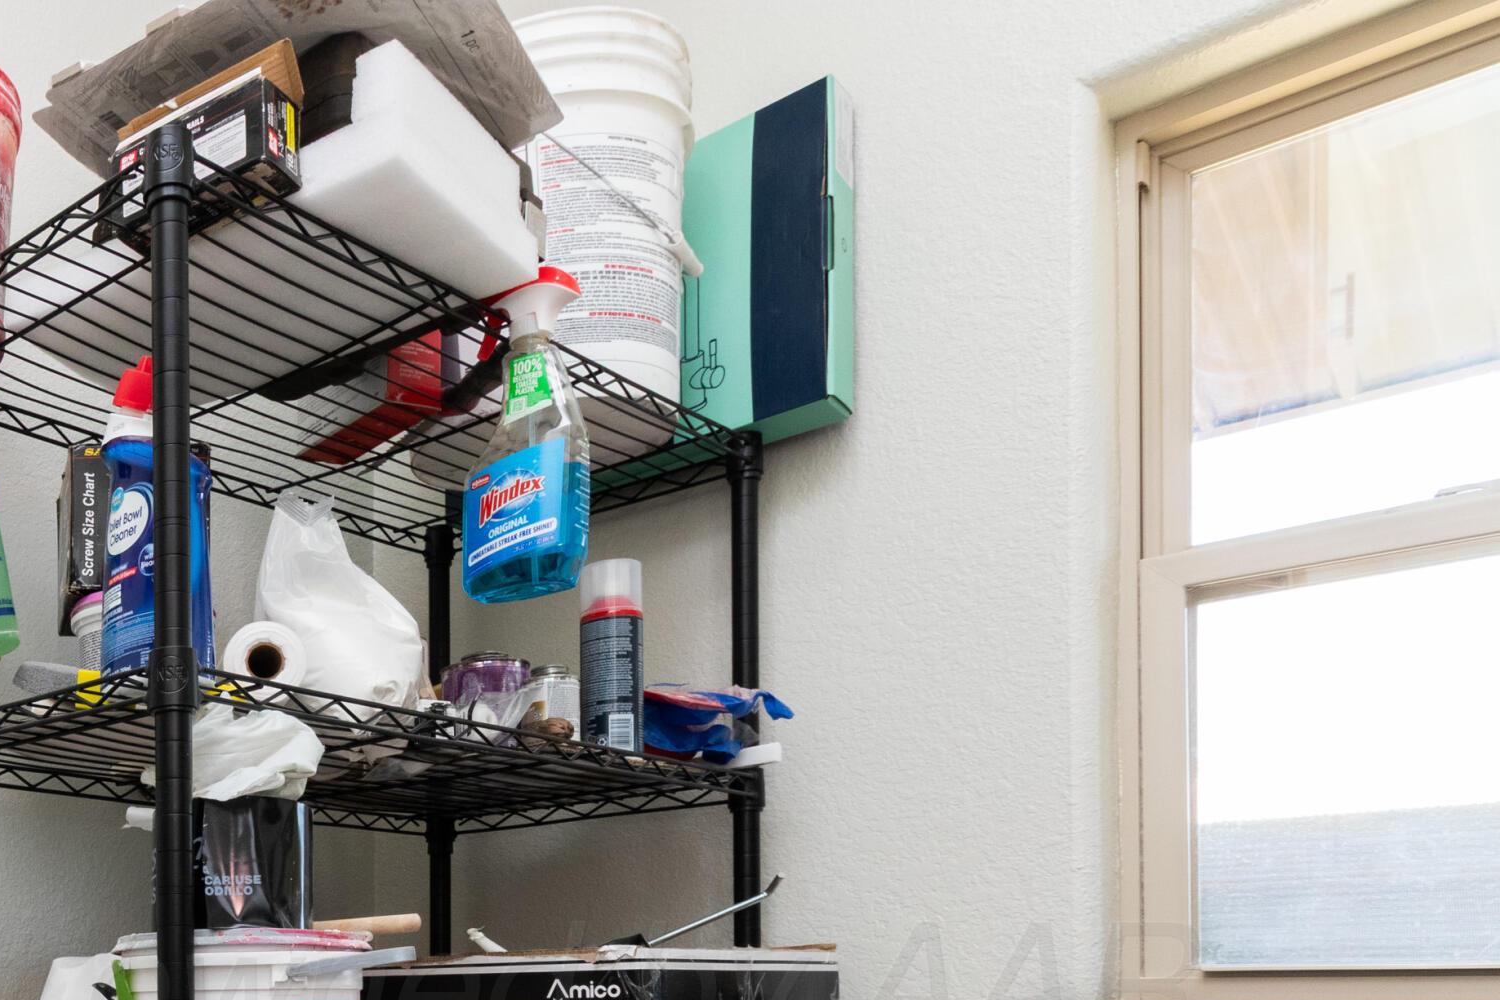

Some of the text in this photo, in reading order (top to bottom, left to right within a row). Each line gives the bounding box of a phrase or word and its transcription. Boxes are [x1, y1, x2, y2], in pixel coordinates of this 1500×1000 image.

[513, 359, 542, 376] 100%
[82, 472, 95, 507] Chart
[480, 476, 544, 528] Windex
[82, 509, 95, 536] Size
[123, 506, 143, 525] Bowl
[488, 515, 529, 539] ORIGINAL
[82, 539, 95, 577] Screw
[546, 978, 621, 999] Amico
